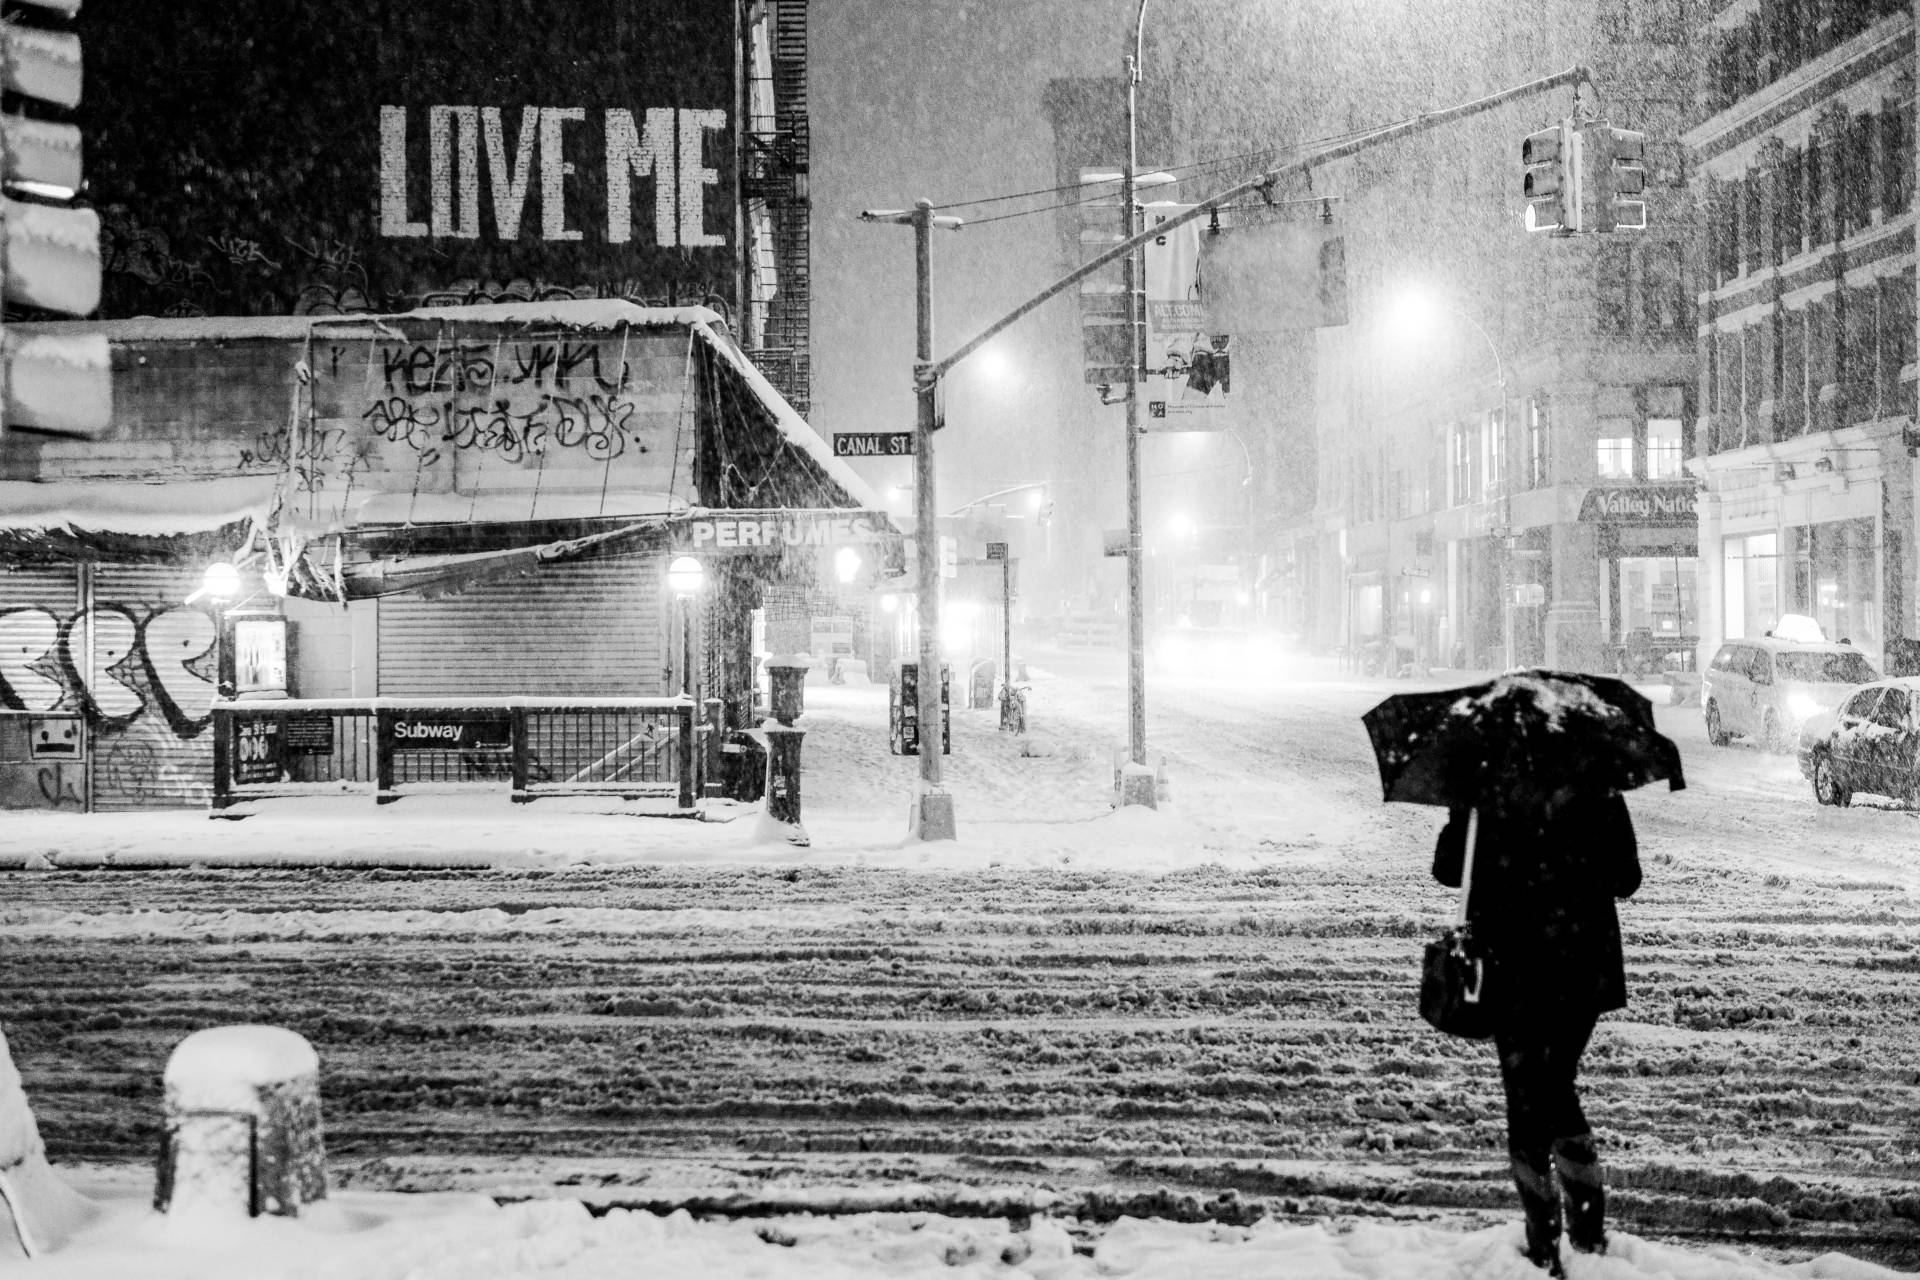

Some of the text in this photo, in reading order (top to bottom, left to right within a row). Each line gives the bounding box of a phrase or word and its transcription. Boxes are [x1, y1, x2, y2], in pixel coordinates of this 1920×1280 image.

[379, 105, 728, 247] LOVE ME
[837, 436, 908, 455] CANAL ST
[1597, 491, 1650, 518] Valley
[692, 518, 876, 548] PERFUMES
[394, 721, 463, 742] Subway
